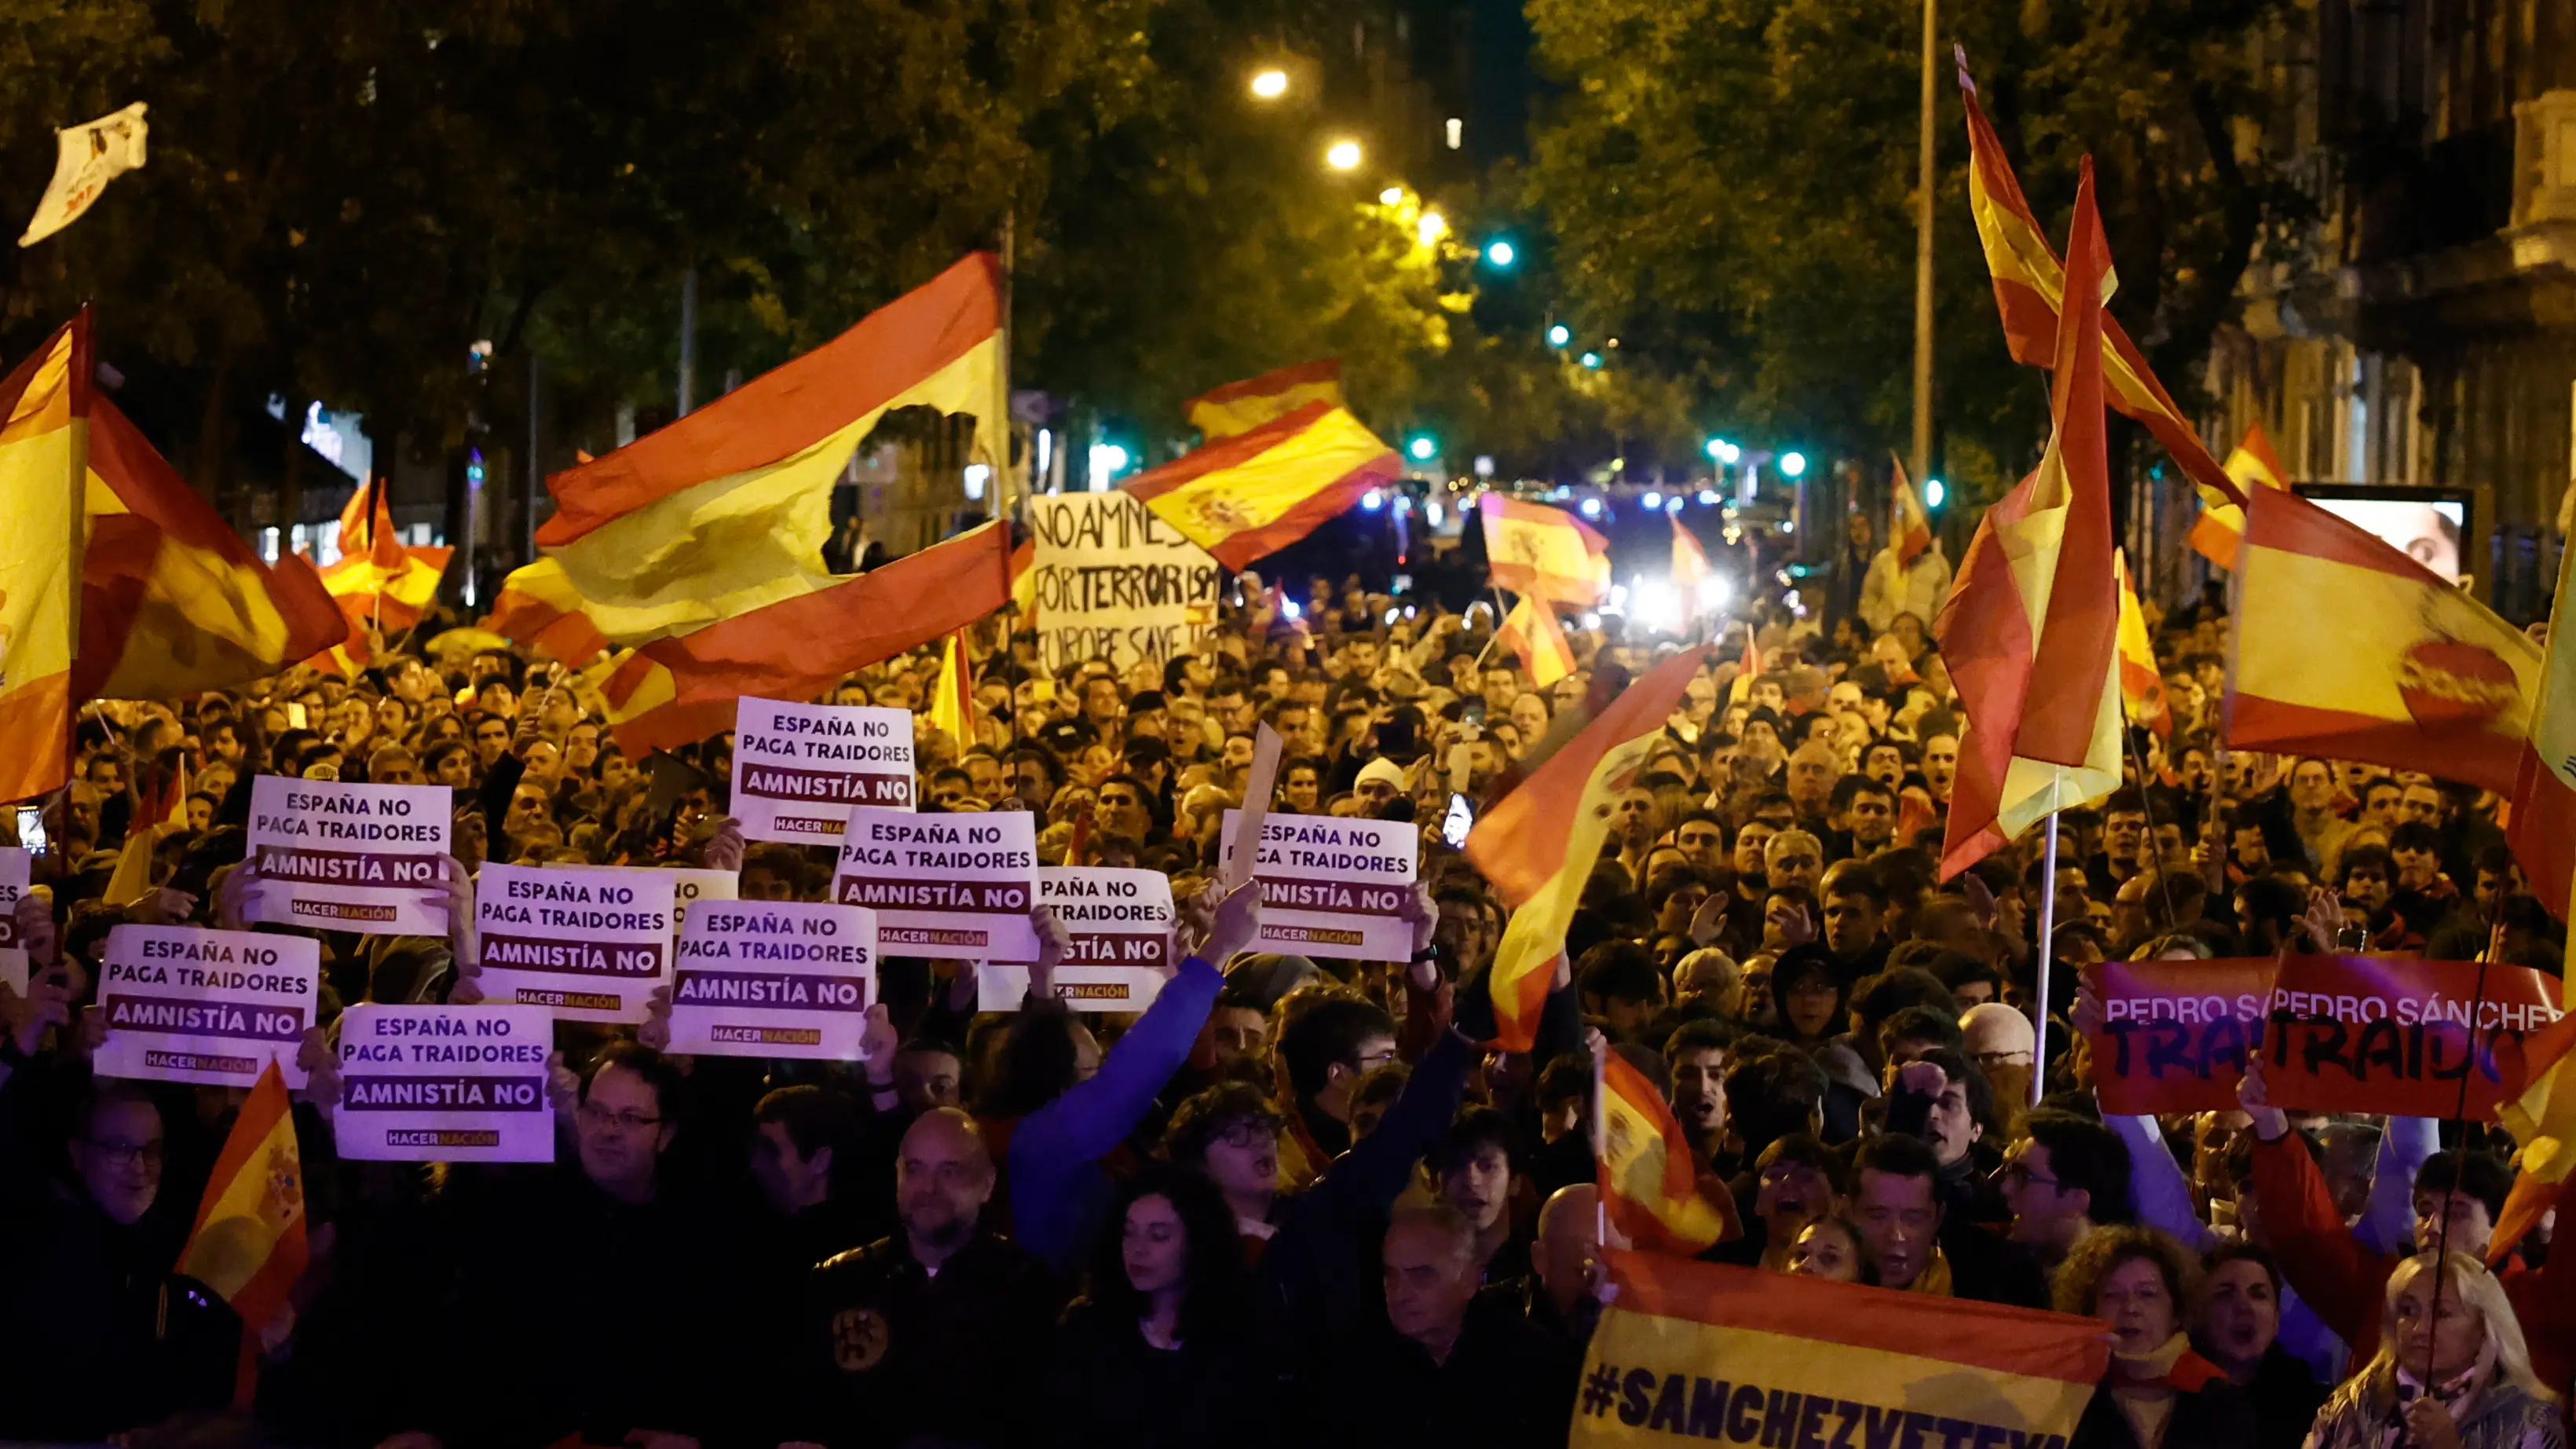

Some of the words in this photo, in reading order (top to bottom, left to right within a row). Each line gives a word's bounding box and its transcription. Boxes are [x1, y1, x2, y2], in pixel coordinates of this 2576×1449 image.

[1034, 503, 1075, 548] NO
[1075, 497, 1191, 548] AMNE
[1035, 563, 1078, 613] FOR
[773, 715, 856, 737] ESPAÑA
[864, 721, 889, 737] NO
[743, 734, 796, 756] PAGA
[804, 742, 909, 763] TRAIDORES
[747, 771, 867, 799] AMNISTÍA
[876, 781, 908, 800] NO
[287, 793, 371, 814] ESPAÑA
[379, 800, 411, 816] NO
[257, 815, 309, 836] PAGA
[317, 821, 441, 842] TRAIDORES
[775, 819, 846, 834] HACERNA
[872, 824, 961, 844] ESPAÑA
[968, 827, 1001, 843] NO
[1261, 825, 1341, 846] ESPAÑA
[1349, 831, 1381, 847] NO
[262, 854, 384, 880] AMNISTÍA
[394, 862, 431, 881] NO
[842, 844, 897, 866] PAGA
[906, 851, 1030, 869] TRAIDORES
[1290, 851, 1408, 873] TRAIDORES
[508, 880, 591, 903] ESPAÑA
[599, 887, 634, 905] NO
[844, 883, 975, 906] AMNISTÍA
[984, 889, 1024, 908] NO
[1041, 876, 1100, 897] PAÑA
[1107, 881, 1137, 898] NO
[1262, 883, 1352, 908] NISTÍA
[1362, 890, 1399, 910] NO
[293, 902, 395, 920] HACERNACIÓN
[481, 902, 532, 924] PAGA
[540, 909, 664, 931] TRAIDORES
[1051, 905, 1168, 920] TRAIDORES
[708, 913, 793, 935] ESPAÑA
[803, 919, 837, 935] NO
[880, 930, 987, 946] HACERNACIÓN
[1261, 927, 1363, 945] HACERNACIÓN
[143, 941, 234, 964] ESPAÑA
[243, 948, 277, 966] NO
[485, 942, 607, 969] AMNISTÍA
[617, 950, 656, 971] NO
[679, 941, 730, 957] PAGA
[740, 942, 868, 964] TRAIDORES
[1125, 940, 1161, 960] NO
[109, 964, 167, 983] PAGA
[177, 968, 308, 994] TRAIDORES
[679, 977, 808, 1002] AMNISTÍA
[818, 983, 858, 1004] NO
[517, 990, 620, 1010] HACERNACIÓN
[2106, 995, 2227, 1025] PEDRO
[2274, 987, 2388, 1024] PEDRO
[113, 1003, 245, 1031] AMNISTÍA
[255, 1013, 295, 1035] NO
[375, 1015, 467, 1036] ESPAÑA
[477, 1019, 510, 1036] NO
[712, 1028, 820, 1044] HACERNACIÓN
[148, 1053, 256, 1073] HACERNACIÓN
[343, 1045, 403, 1062] PAGA
[412, 1045, 543, 1063] TRAIDORES
[350, 1079, 485, 1104] AMNISTÍA
[495, 1085, 535, 1104] NO
[389, 1132, 499, 1145] HACERNACIÓN
